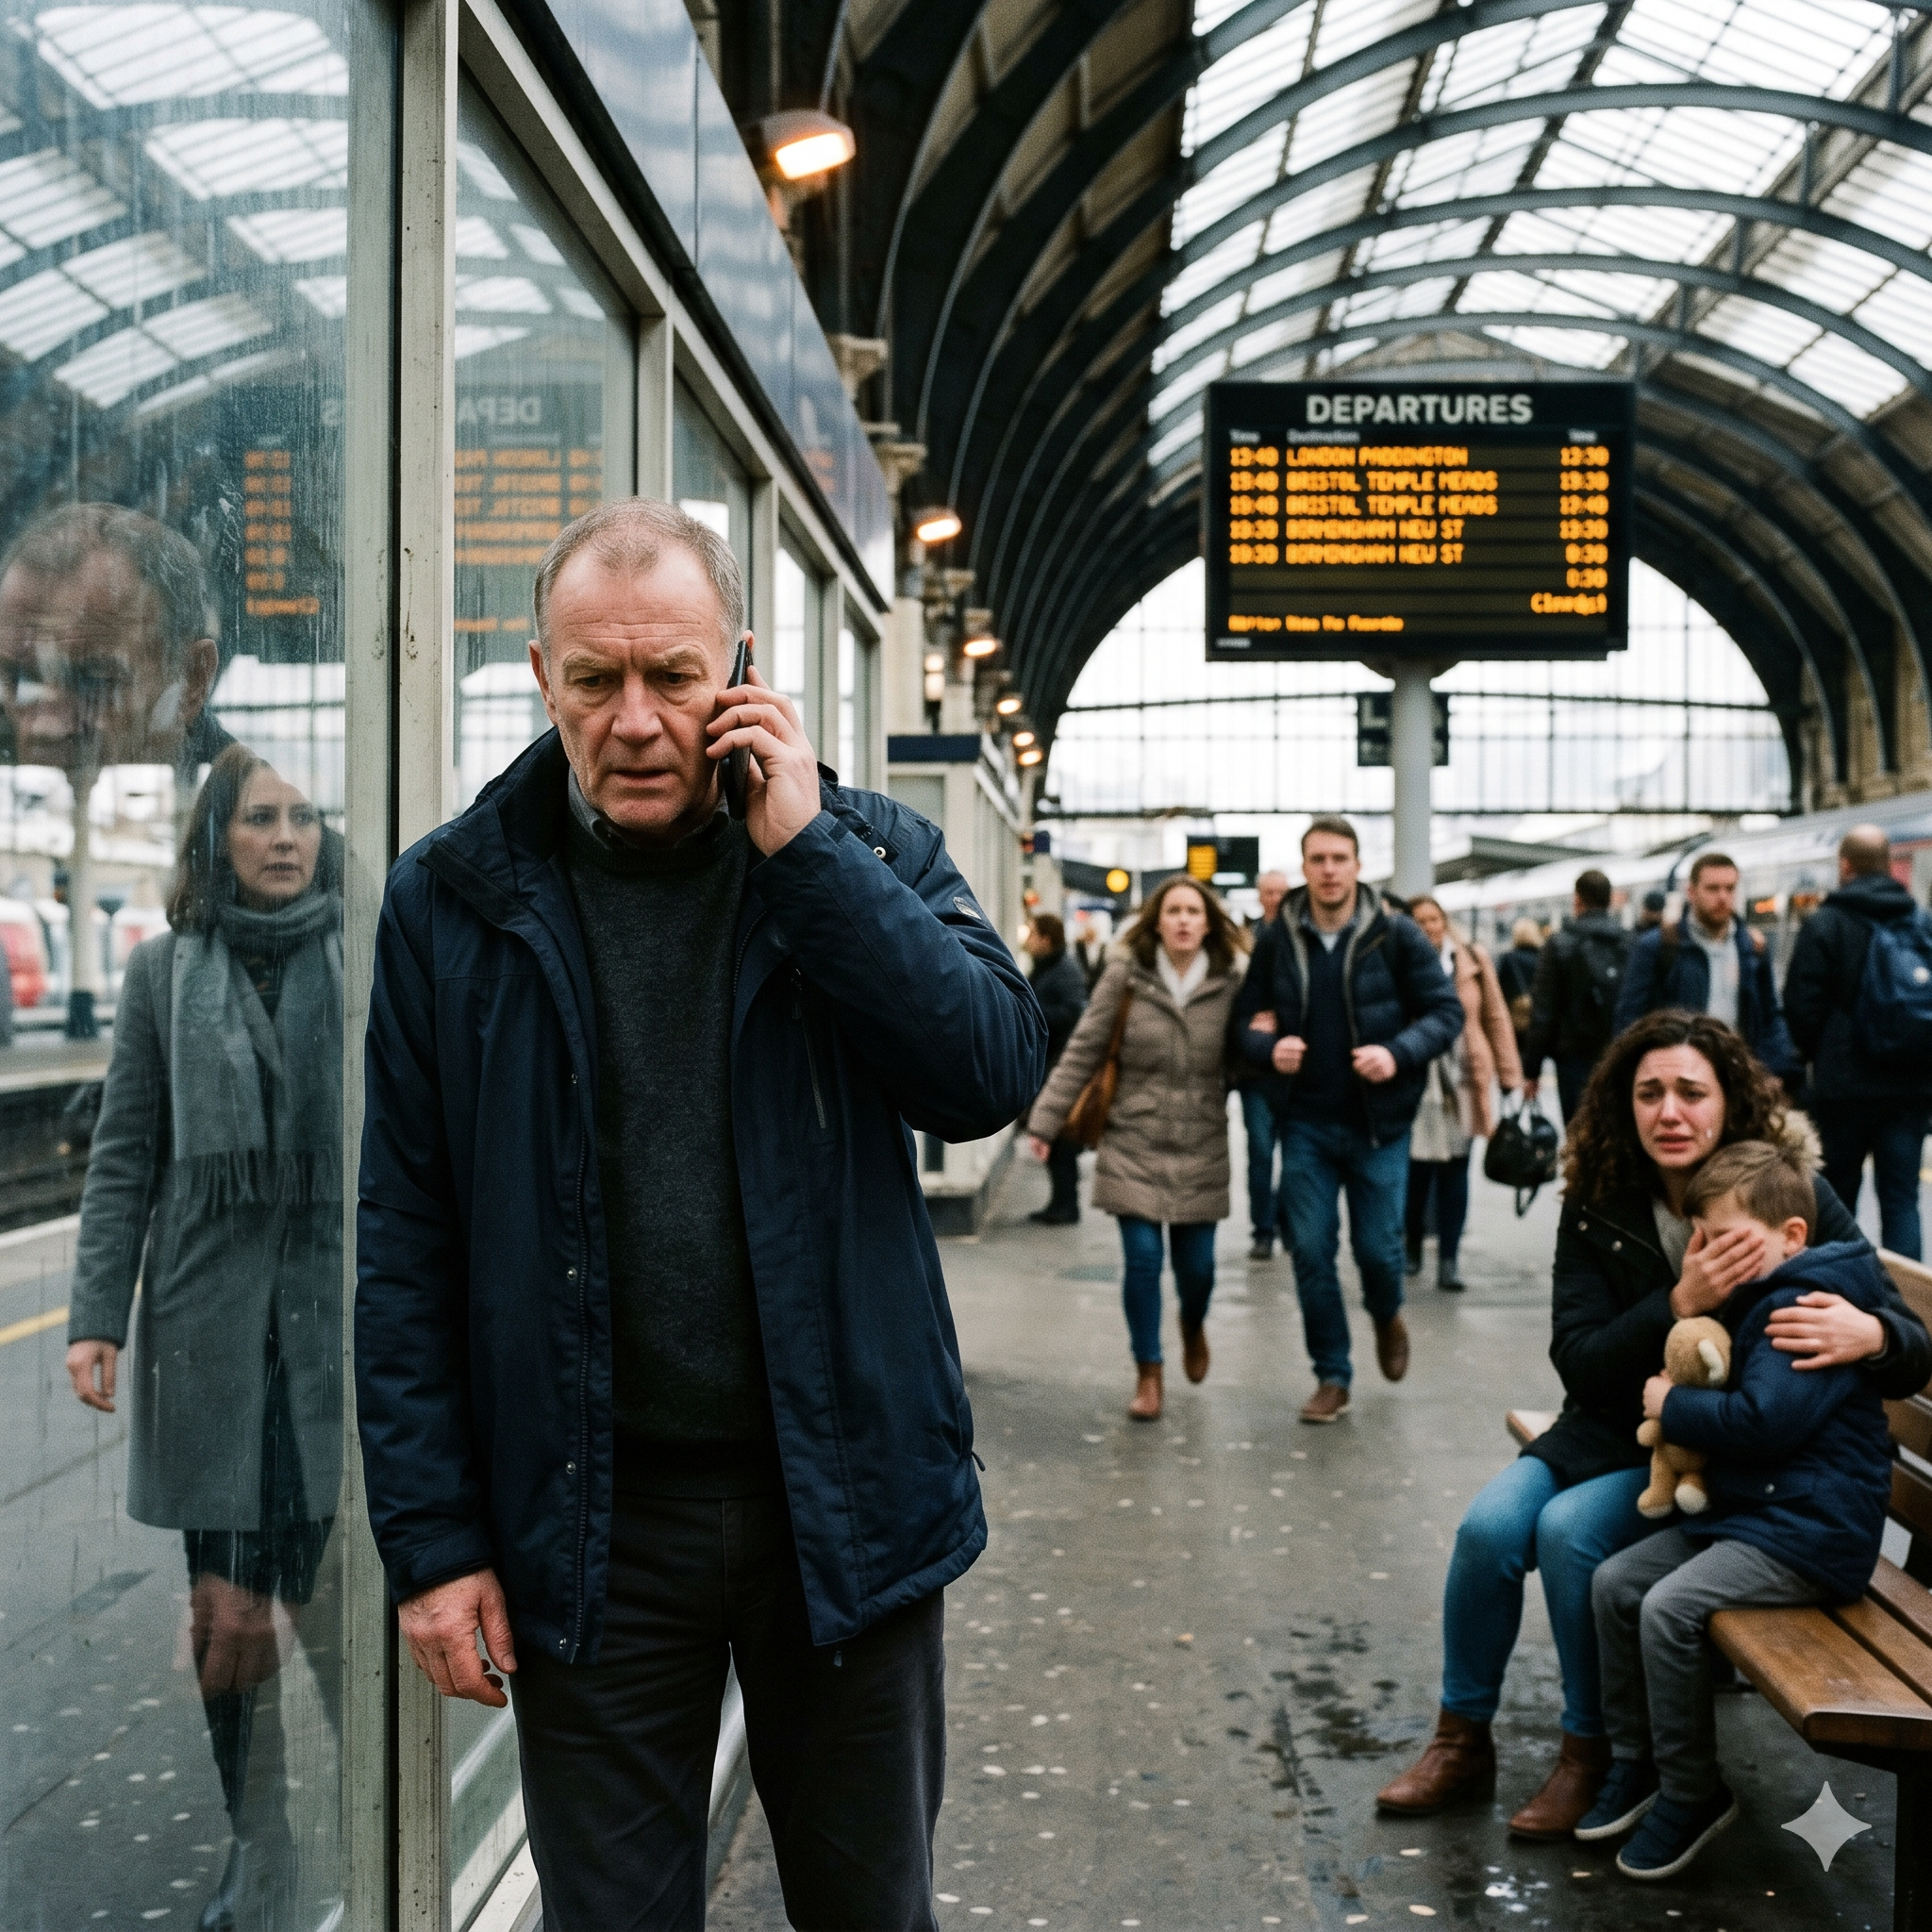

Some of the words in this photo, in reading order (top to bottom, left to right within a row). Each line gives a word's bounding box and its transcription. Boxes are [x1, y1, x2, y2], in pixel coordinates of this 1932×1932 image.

[1306, 393, 1533, 425] DEPARTURES
[1287, 471, 1361, 491] BRISTOL
[1367, 471, 1435, 491] TEMPLE
[1287, 495, 1361, 516] BRISTOL
[1367, 495, 1435, 516] TEMPLE
[1441, 519, 1465, 540] ST
[1441, 543, 1465, 564] ST
